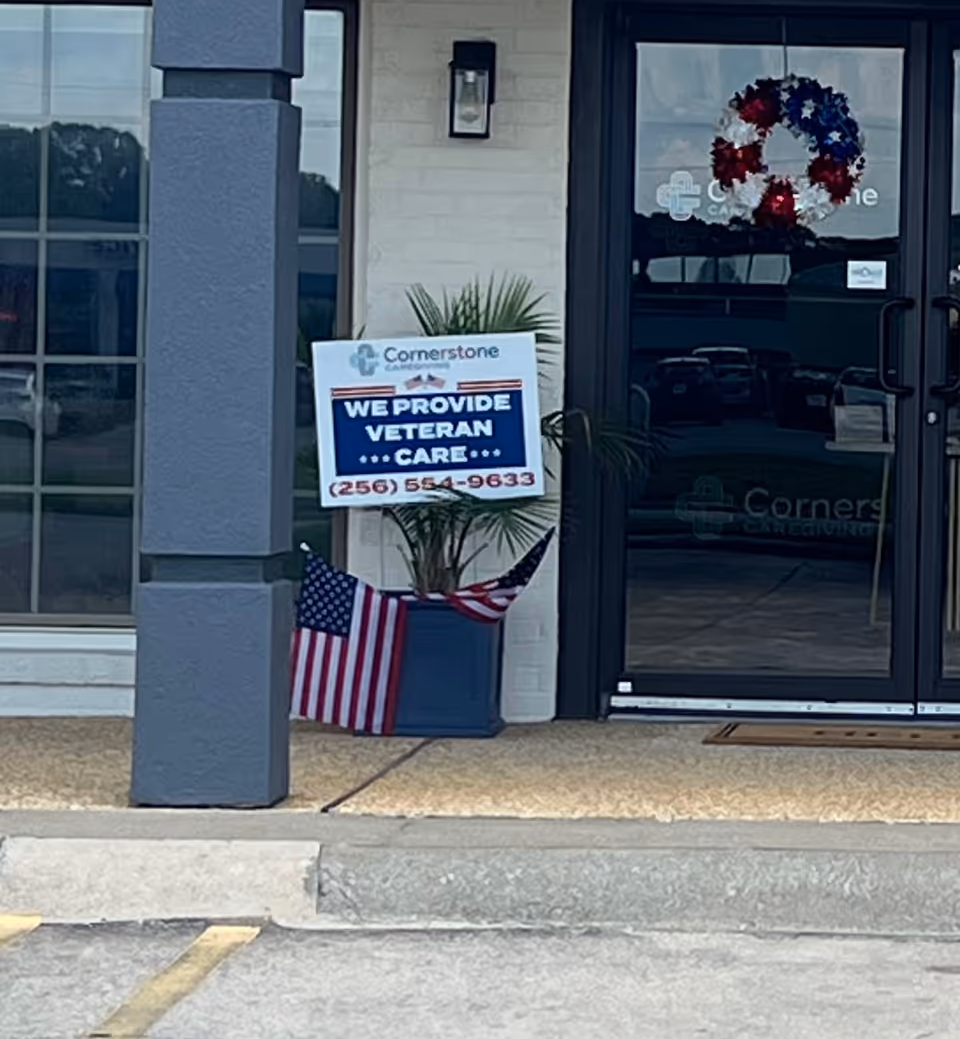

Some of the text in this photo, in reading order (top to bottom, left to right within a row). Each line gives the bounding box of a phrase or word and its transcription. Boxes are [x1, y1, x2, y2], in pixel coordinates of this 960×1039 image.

[384, 344, 499, 363] Cornerstone
[344, 394, 511, 418] WE PROVIDE
[365, 419, 493, 441] VETERAN
[395, 446, 468, 466] CARE
[329, 478, 398, 498] (256)
